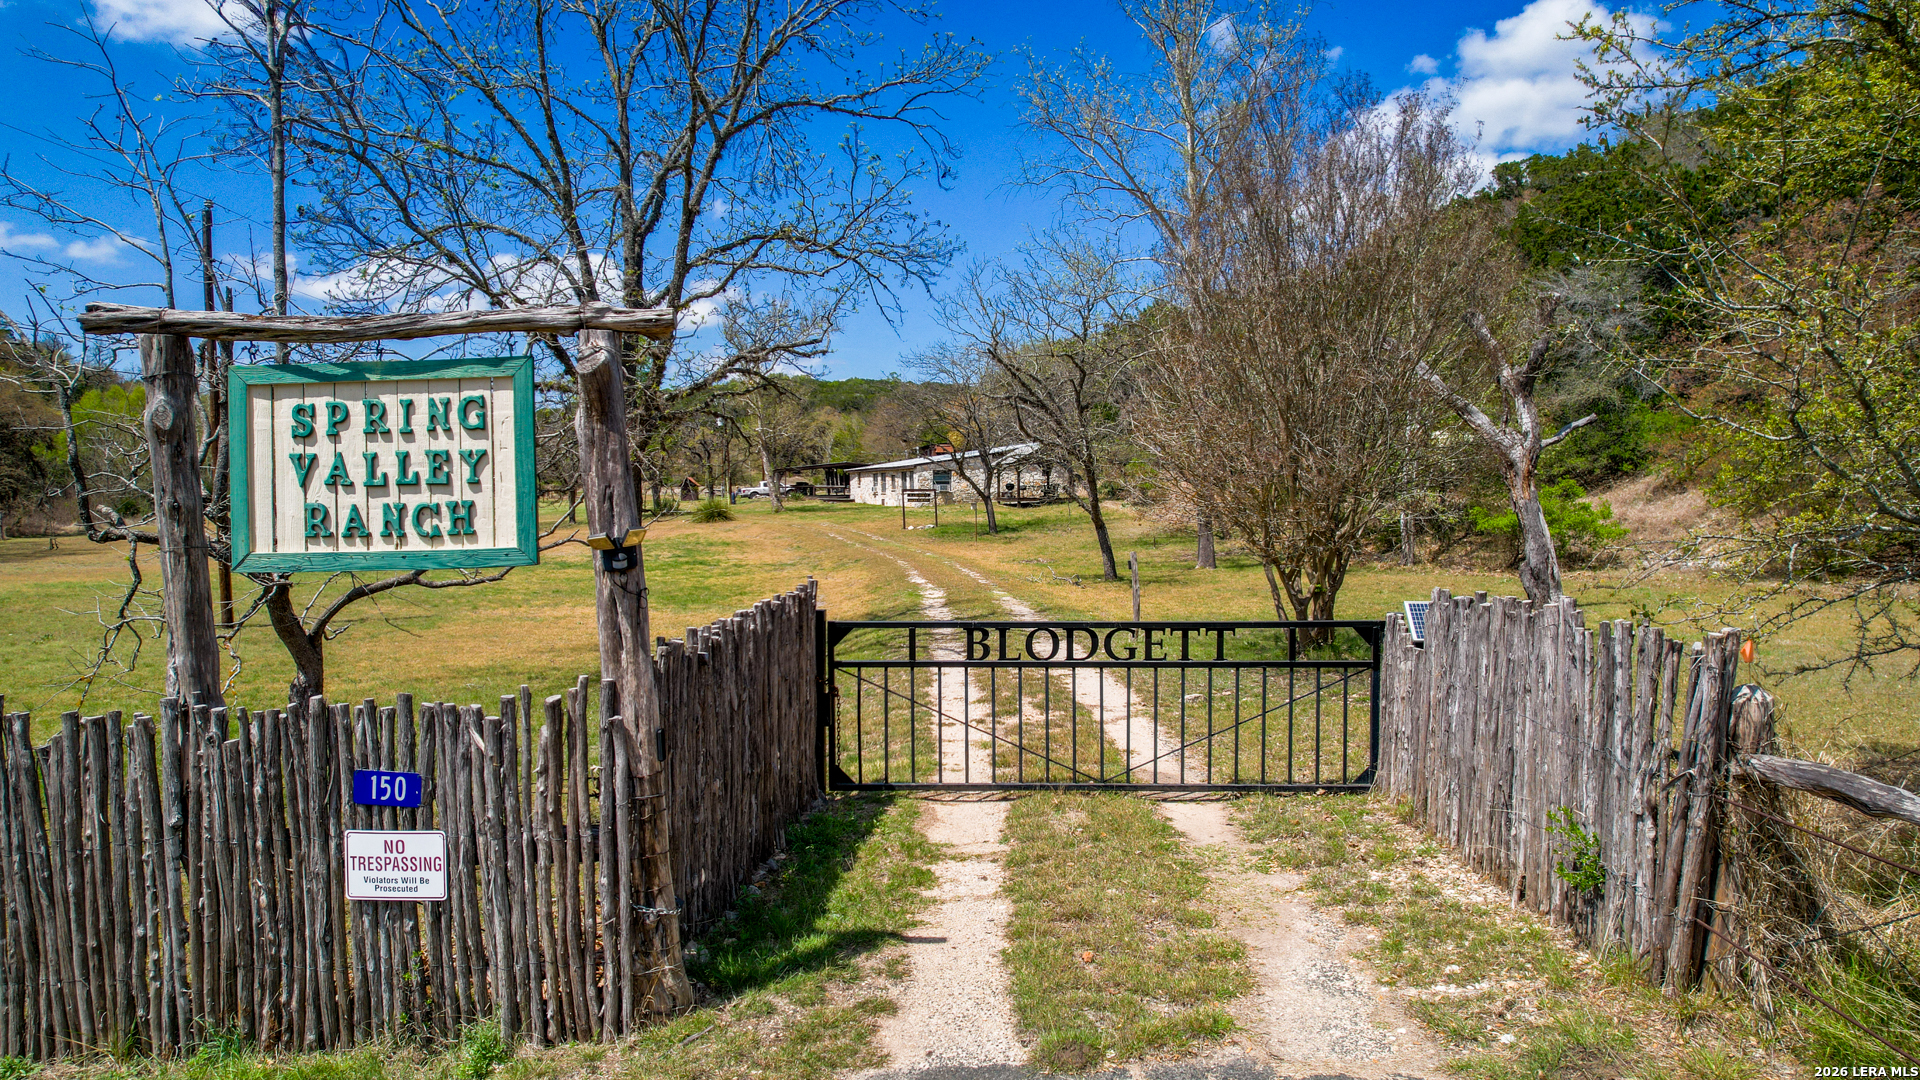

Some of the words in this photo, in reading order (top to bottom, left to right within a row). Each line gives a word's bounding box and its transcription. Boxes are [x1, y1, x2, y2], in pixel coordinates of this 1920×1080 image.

[291, 395, 486, 439] SPRING
[288, 449, 487, 488] VALLEY
[304, 500, 475, 539] RANCH
[963, 627, 1236, 661] BLODGETT
[371, 775, 406, 801] 150
[383, 839, 405, 855] NO
[350, 856, 442, 872] TRESPASSING
[363, 876, 398, 885] Violators
[400, 876, 417, 885] Will
[419, 877, 430, 885] Be
[374, 884, 418, 893] Prosecuted
